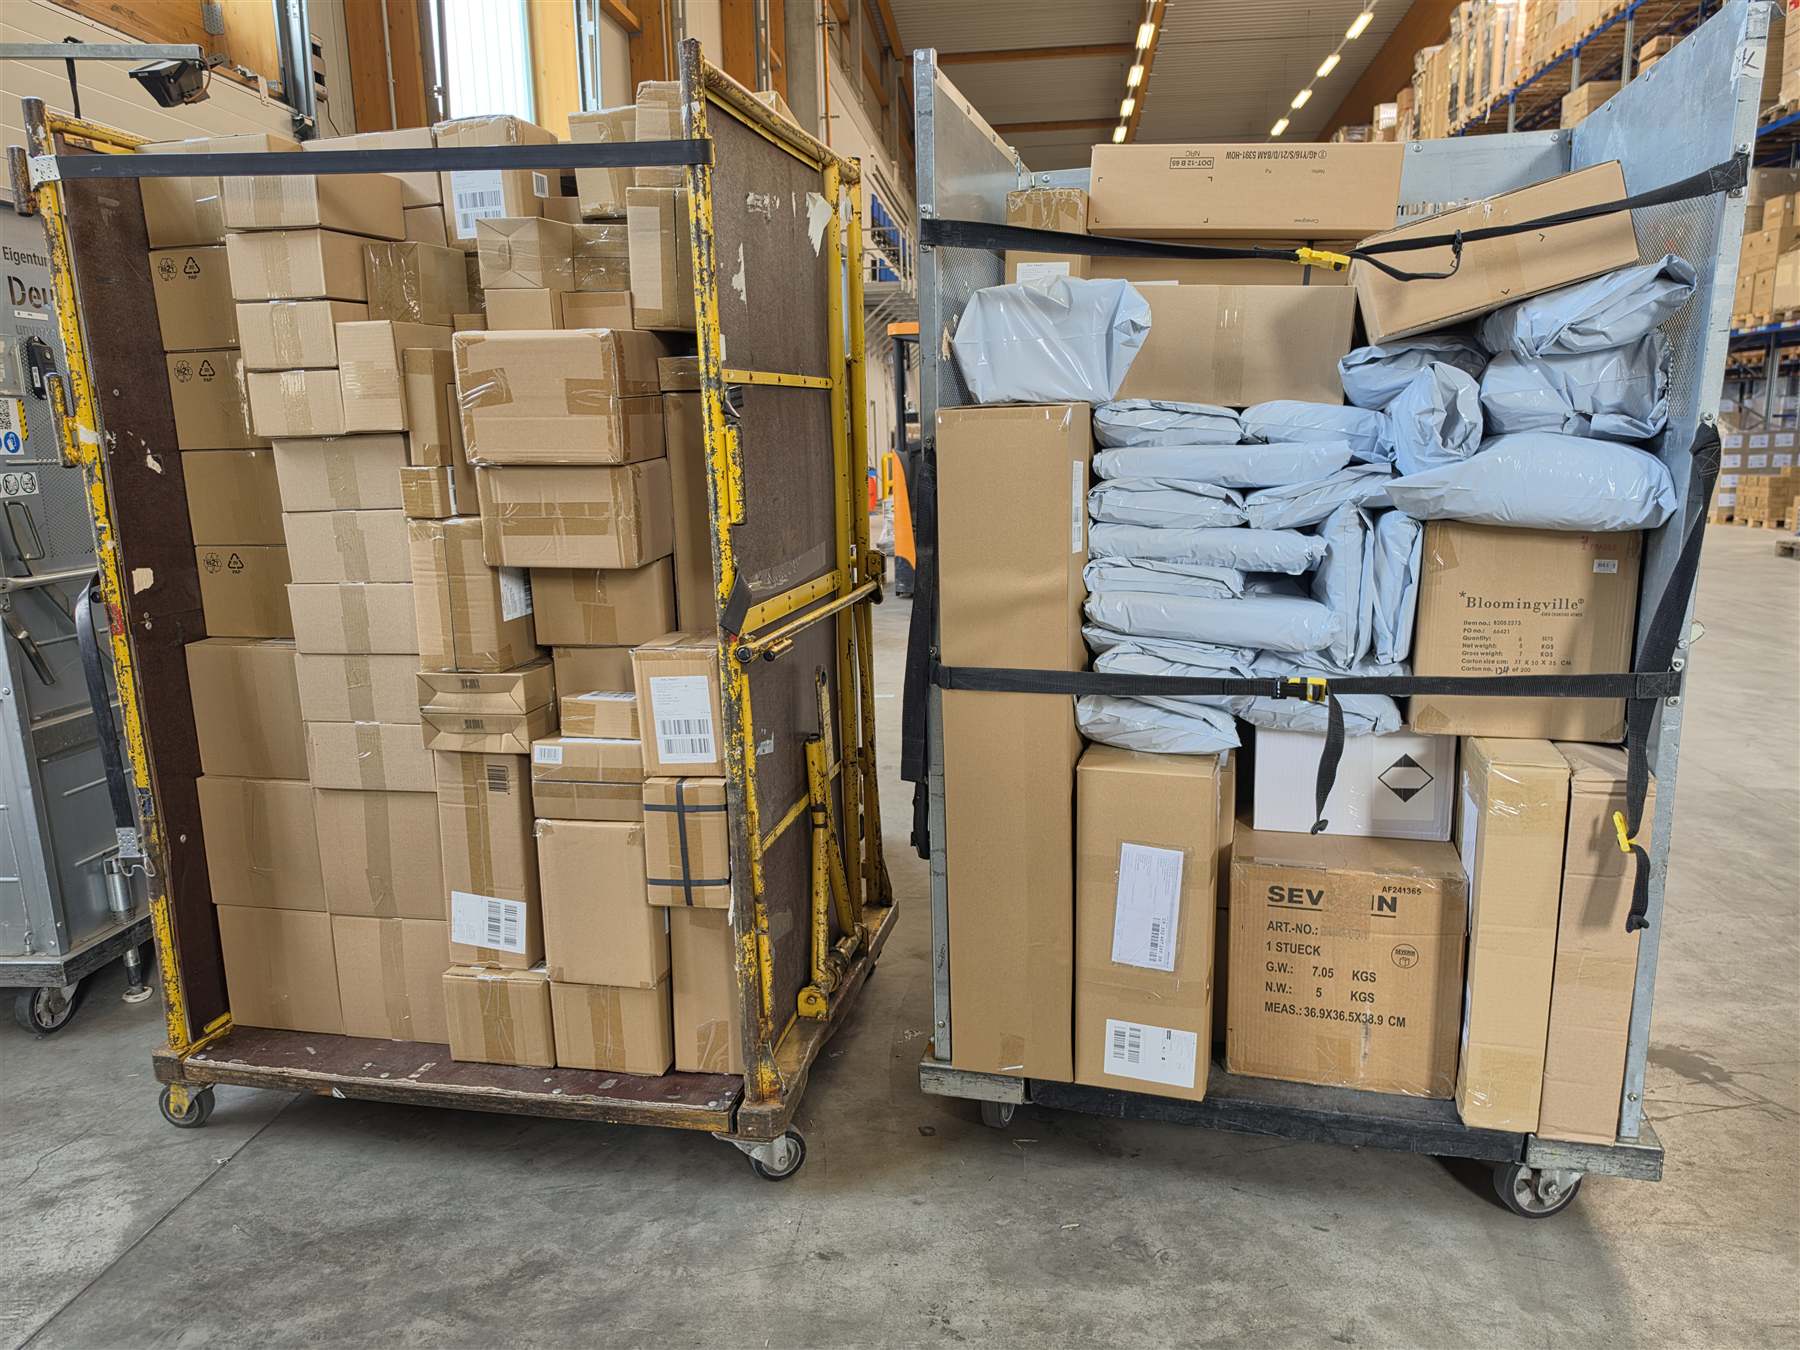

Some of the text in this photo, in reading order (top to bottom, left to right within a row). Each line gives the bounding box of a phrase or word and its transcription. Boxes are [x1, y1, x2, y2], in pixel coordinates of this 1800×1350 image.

[1382, 886, 1422, 896] AF241365
[1266, 941, 1321, 956] 1 STUECK
[1266, 961, 1377, 983] G.W.: 7.05 KGS
[1265, 982, 1375, 1003] N.W.: 5 KGS
[1388, 1016, 1406, 1027] CM
